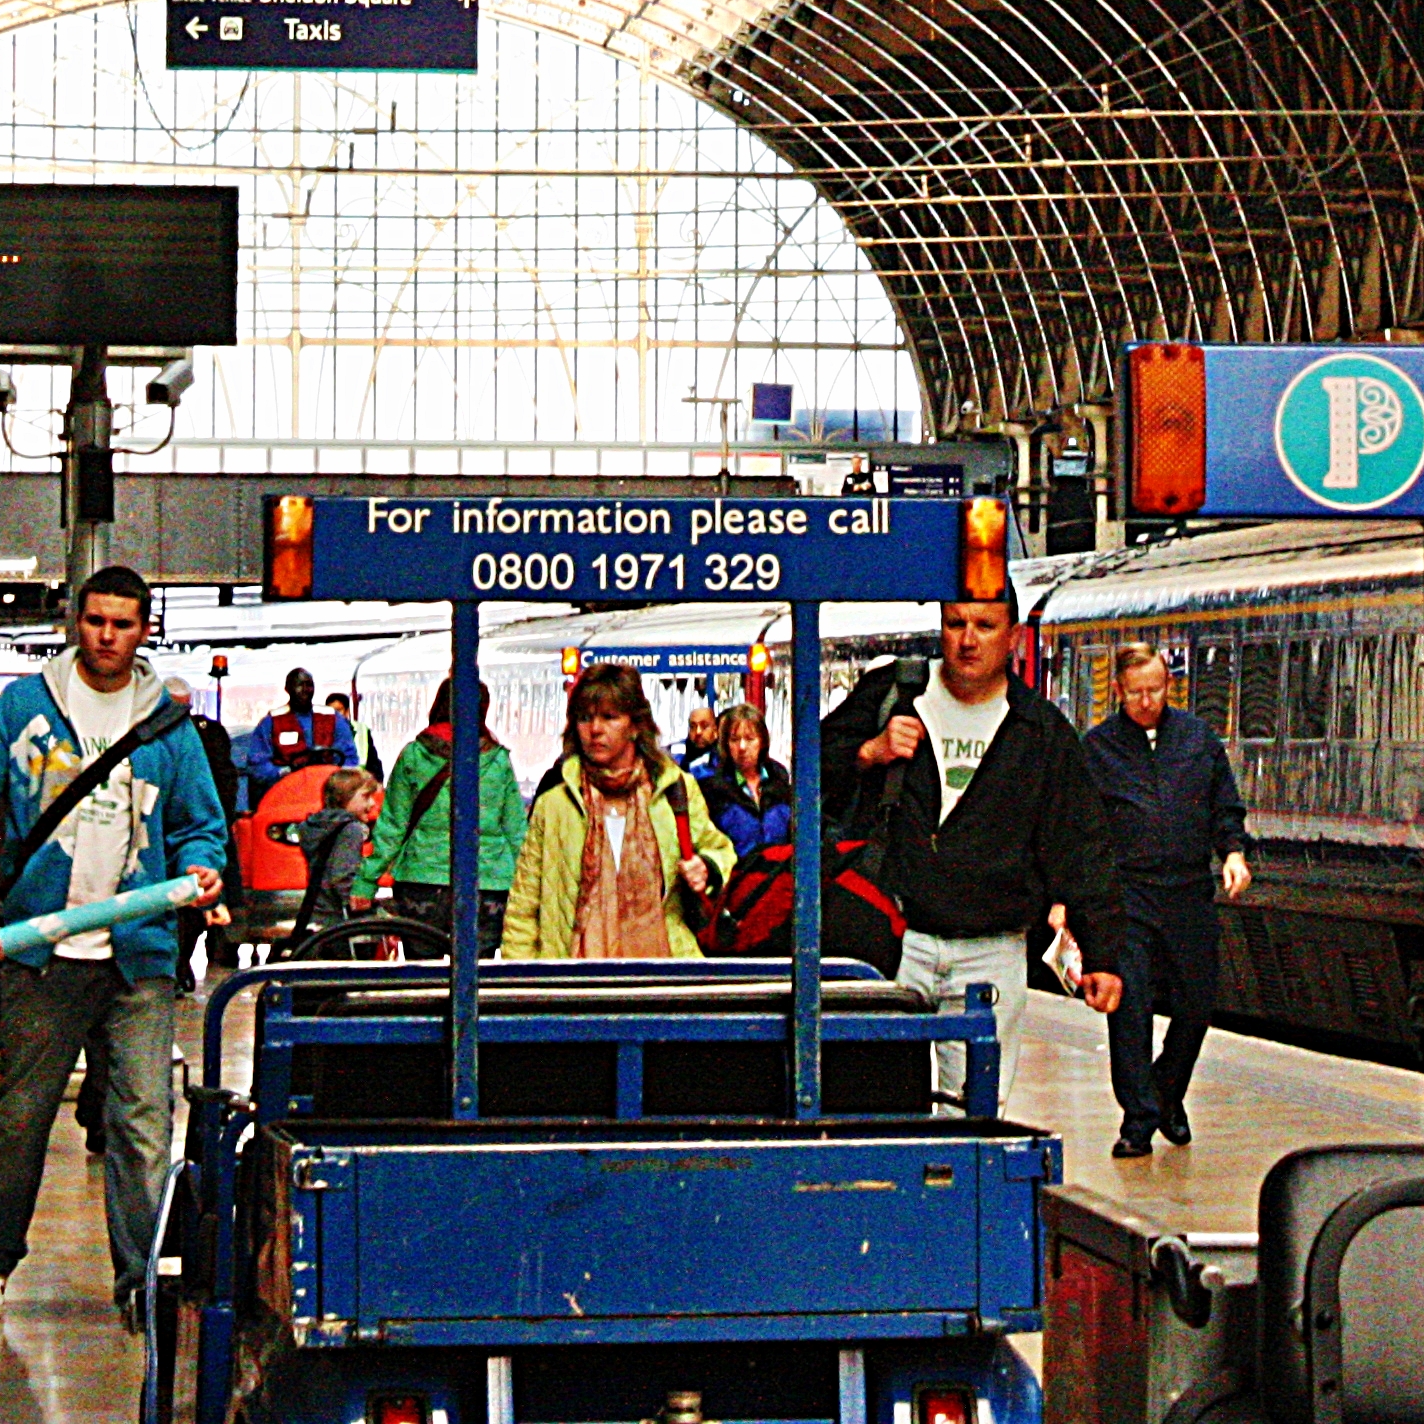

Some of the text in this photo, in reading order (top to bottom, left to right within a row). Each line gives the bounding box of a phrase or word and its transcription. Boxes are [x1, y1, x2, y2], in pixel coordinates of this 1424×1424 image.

[283, 17, 341, 41] Taxis
[368, 499, 889, 546] For information please call
[472, 553, 780, 590] 0800 1971 329
[668, 651, 748, 668] assistance
